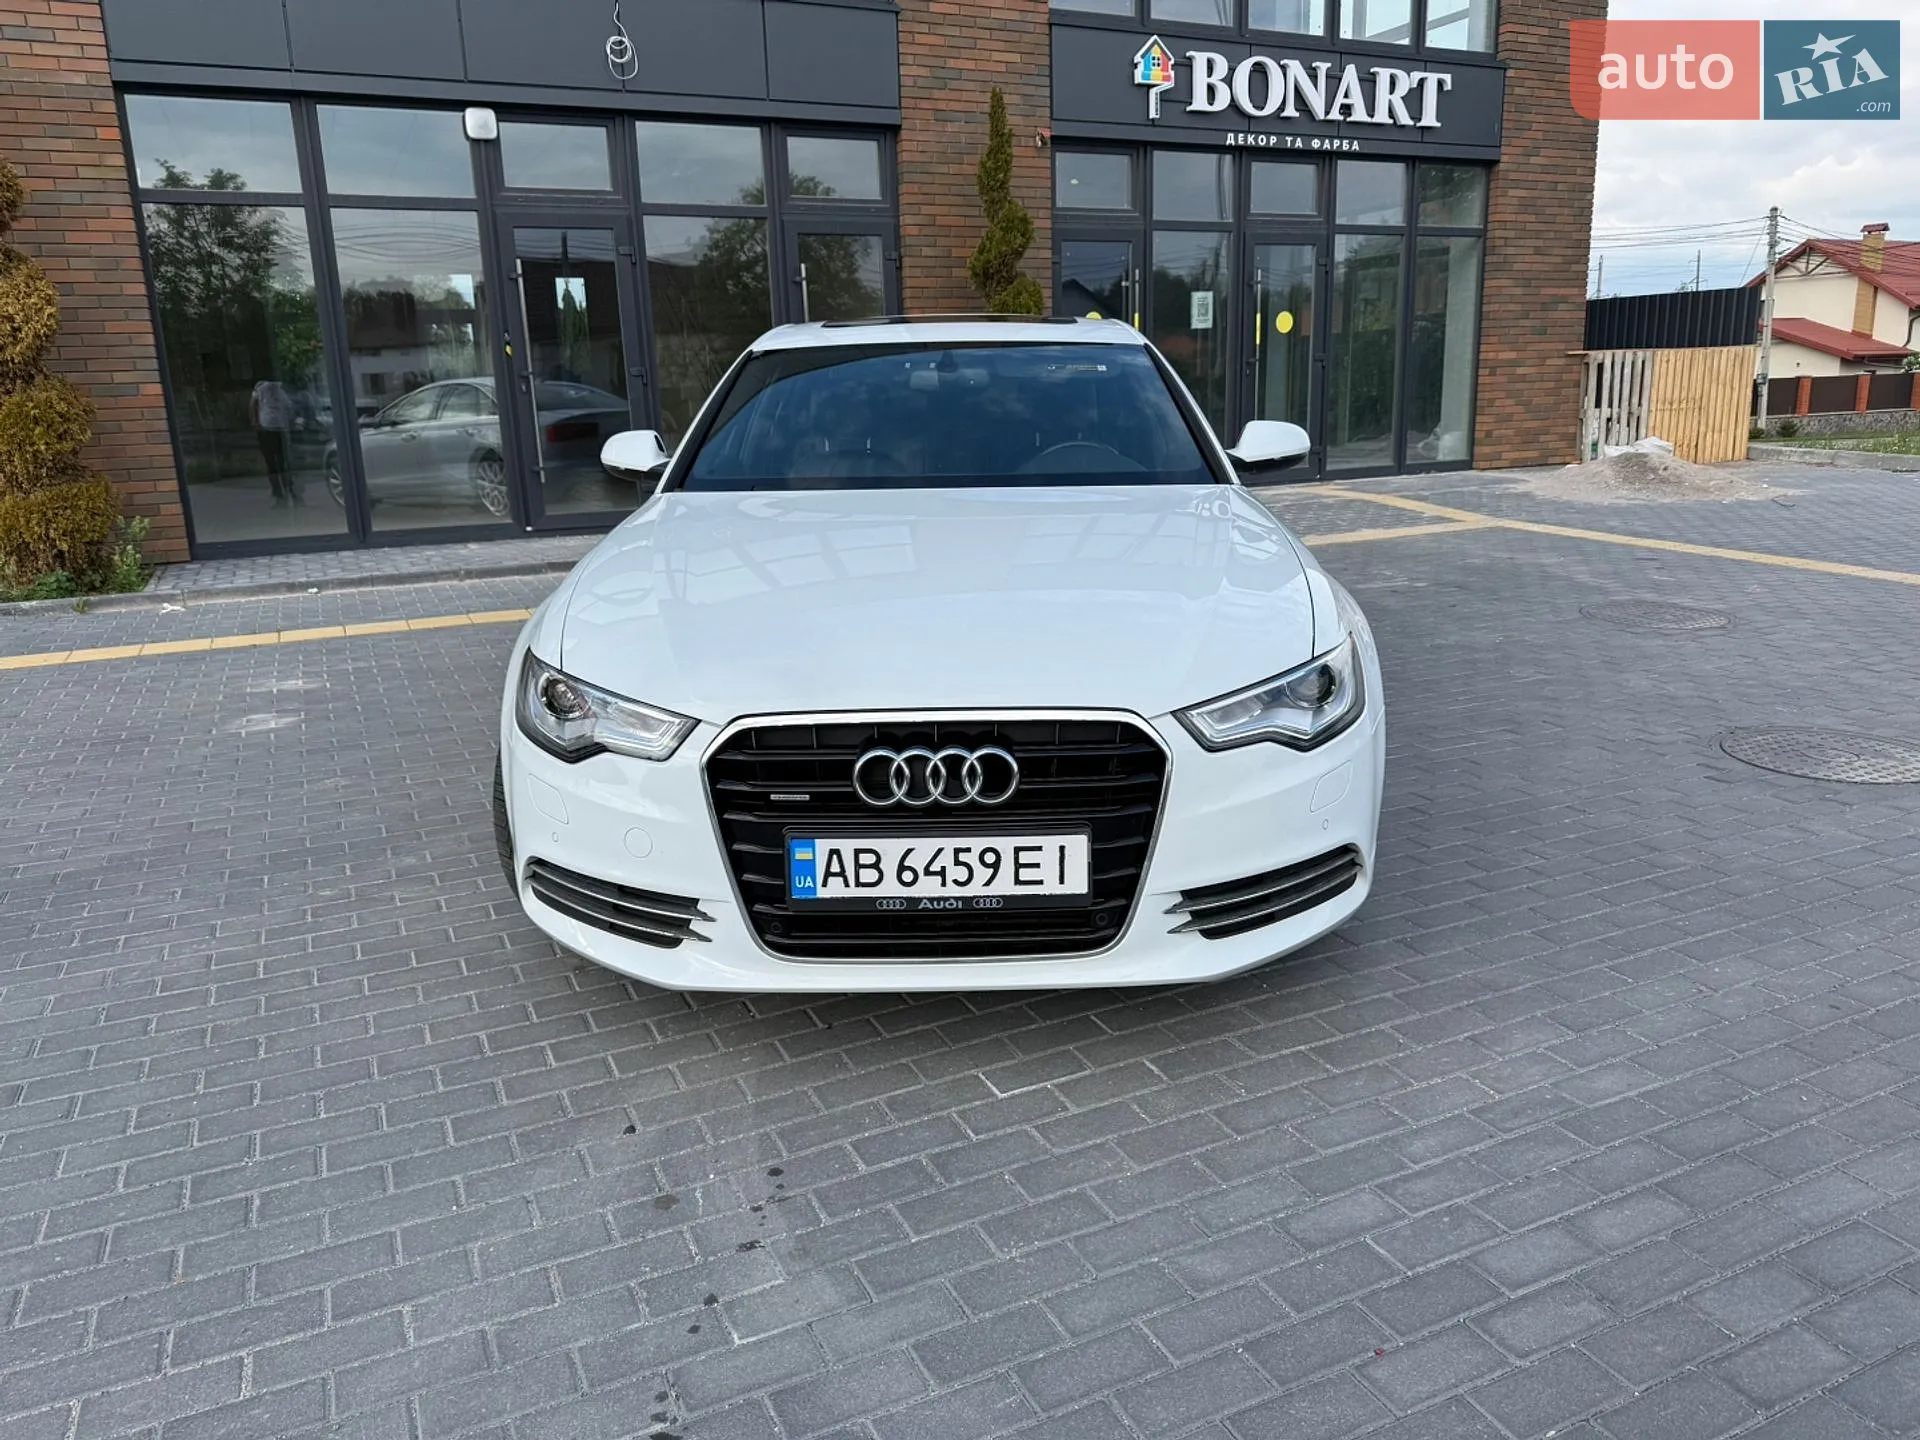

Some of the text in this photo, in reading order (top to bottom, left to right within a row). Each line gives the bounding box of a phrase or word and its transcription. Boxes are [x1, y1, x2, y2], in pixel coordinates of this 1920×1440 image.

[1186, 51, 1451, 127] BONART
[1225, 132, 1361, 152] ДЕКОР ТА ФАРБА
[821, 845, 1067, 888] AB 6459 EI
[795, 875, 814, 889] UA
[918, 897, 963, 910] Audi
